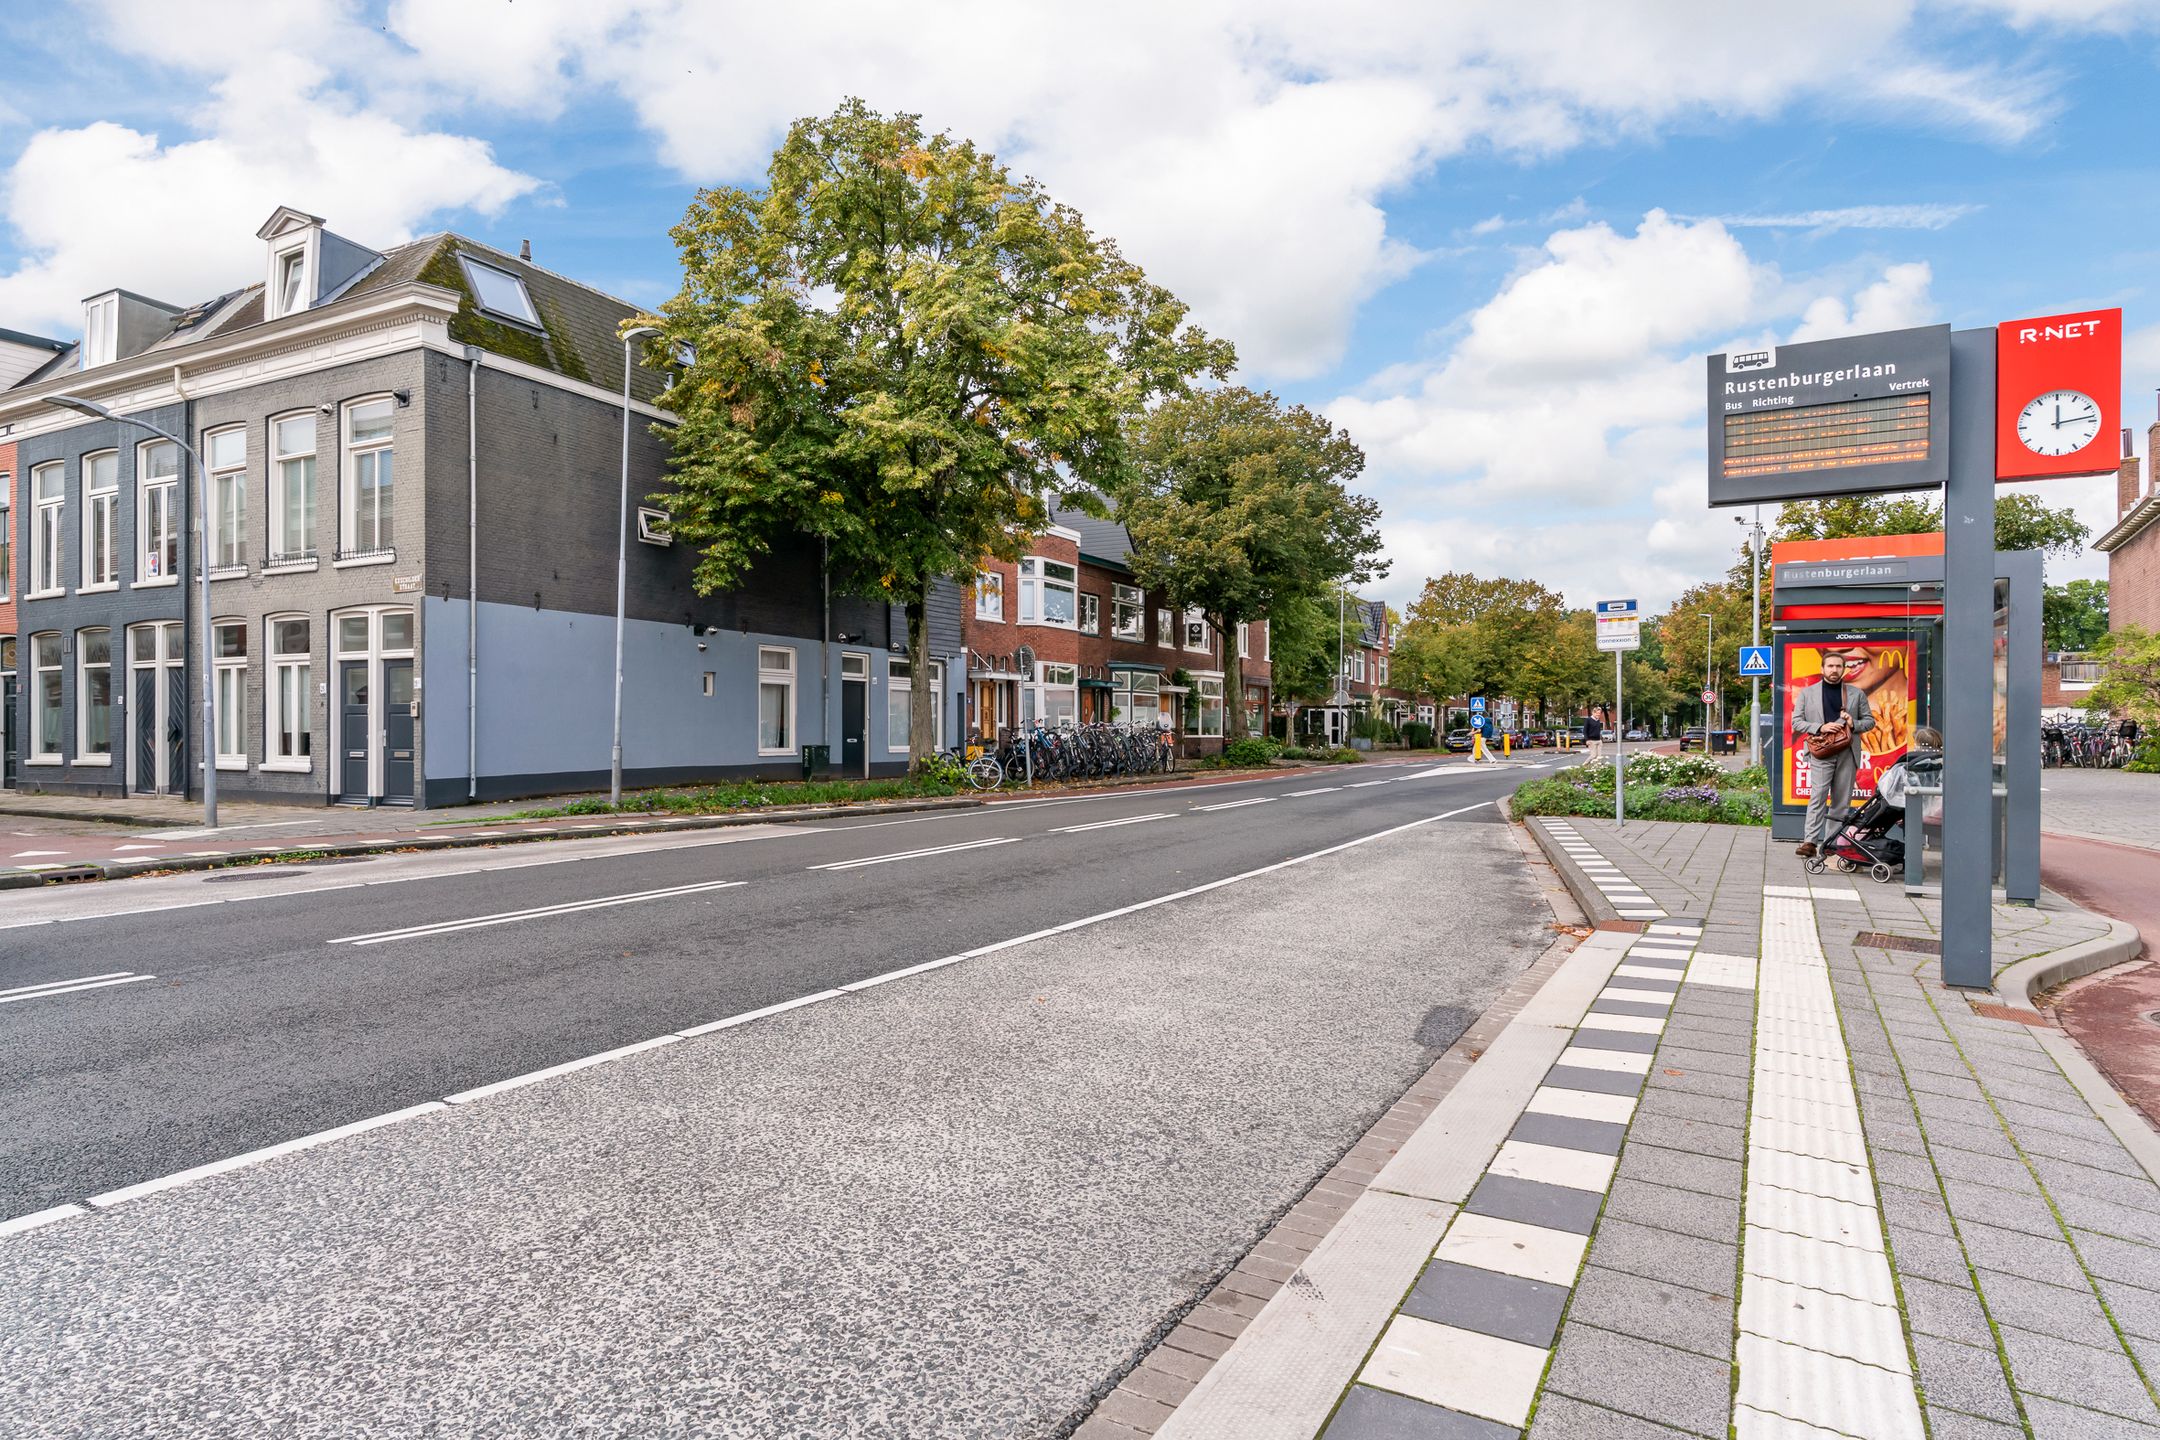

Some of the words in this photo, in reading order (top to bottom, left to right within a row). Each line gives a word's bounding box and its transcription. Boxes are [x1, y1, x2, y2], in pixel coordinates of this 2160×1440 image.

[1725, 363, 1896, 394] Rustenburgerlaan
[1889, 378, 1930, 391] Vertrek
[1725, 401, 1743, 410] Bus
[1752, 395, 1794, 408] Richting
[1783, 565, 1892, 579] Rustenburgerlaan
